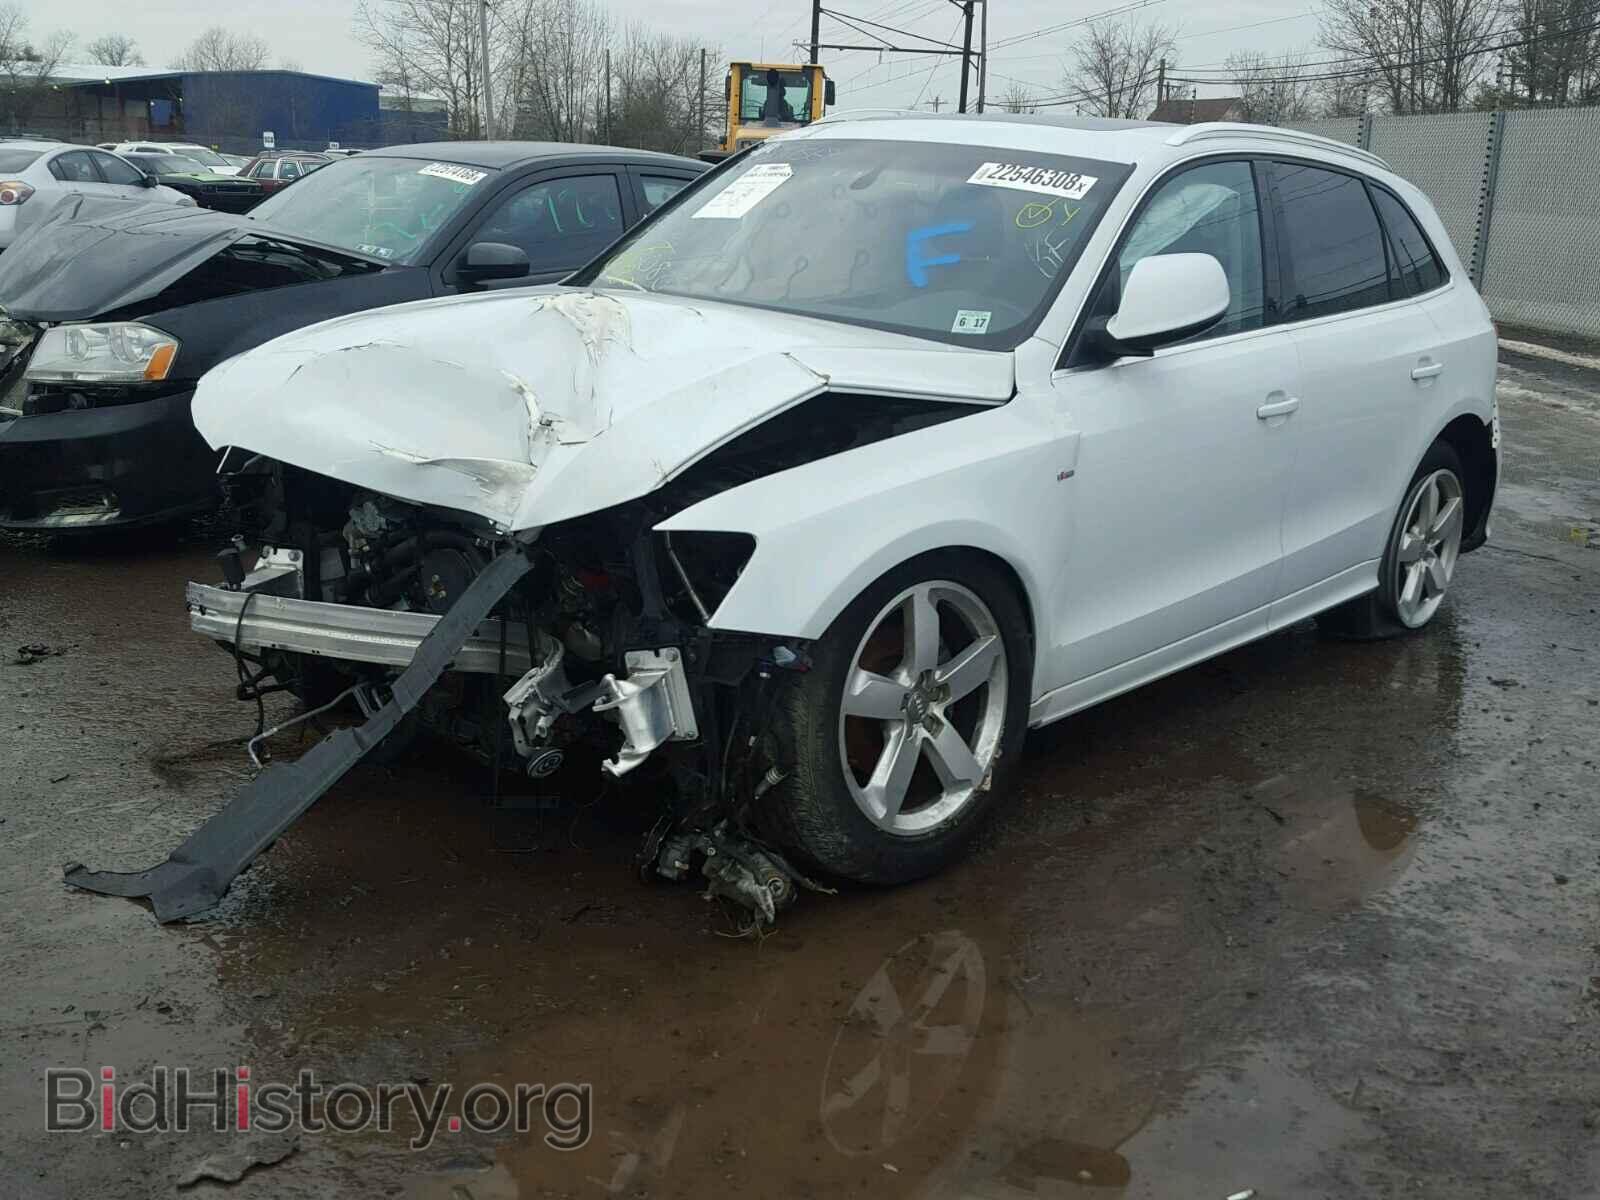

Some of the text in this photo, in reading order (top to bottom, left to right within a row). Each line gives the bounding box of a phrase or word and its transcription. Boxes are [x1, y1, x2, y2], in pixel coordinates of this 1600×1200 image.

[906, 223, 973, 288] F
[958, 316, 988, 328] 6 17
